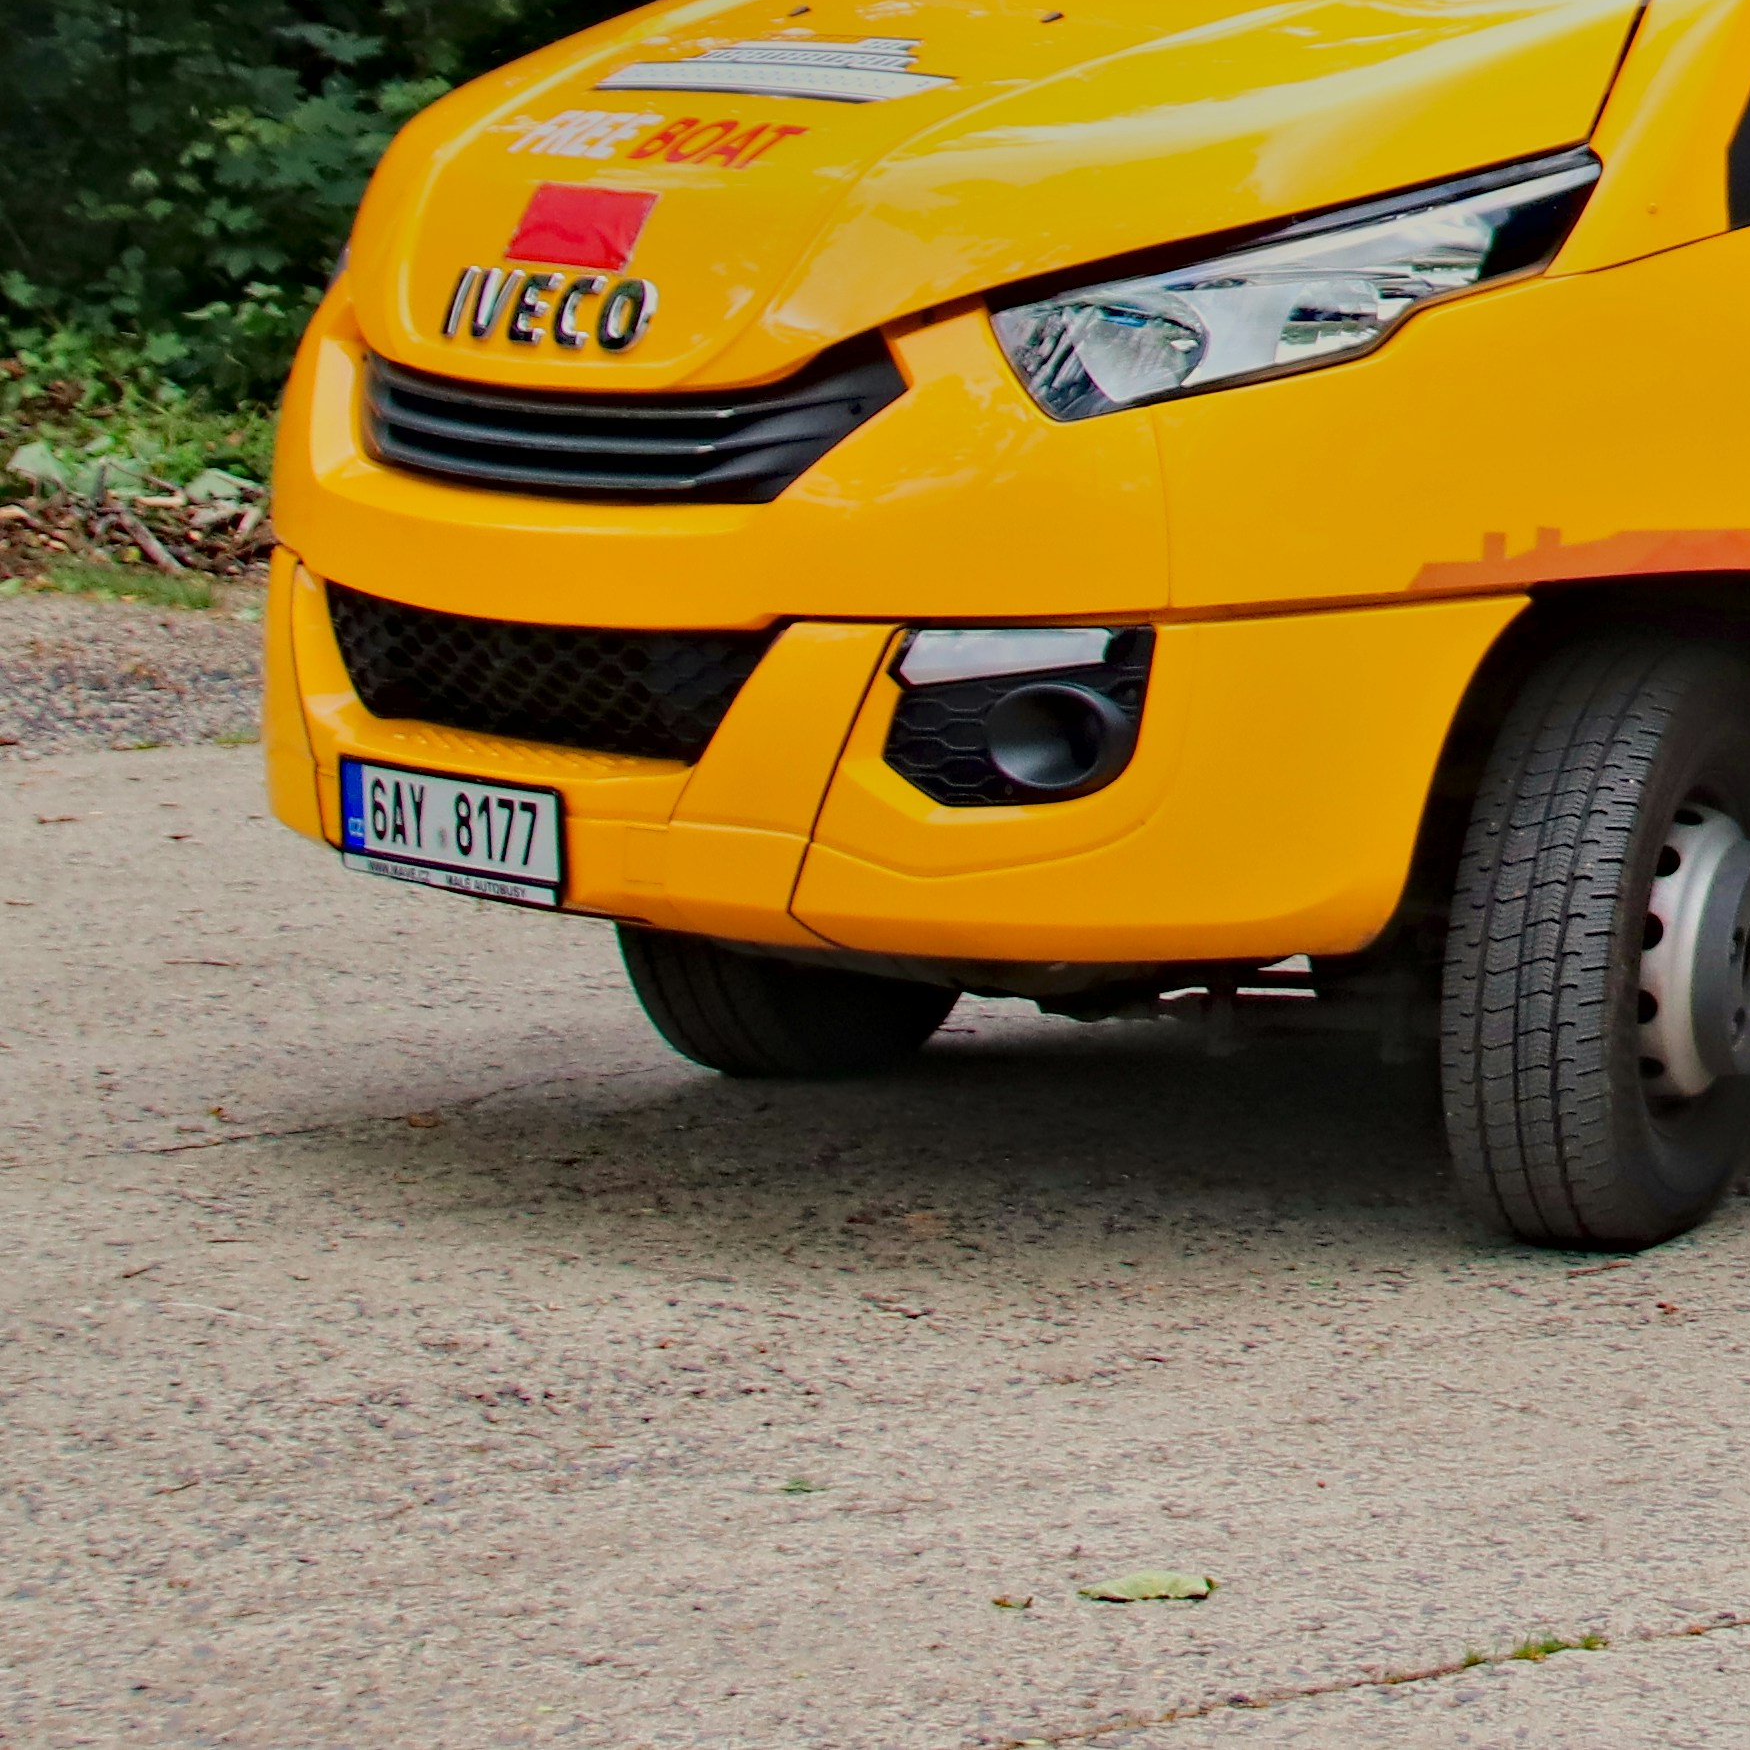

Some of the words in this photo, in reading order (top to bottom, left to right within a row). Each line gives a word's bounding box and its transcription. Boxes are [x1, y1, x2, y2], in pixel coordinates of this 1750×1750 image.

[507, 110, 665, 161] FREE
[627, 116, 811, 170] BOAT
[443, 264, 660, 354] IVECO
[371, 776, 425, 848] 6AY
[455, 791, 538, 867] 8177
